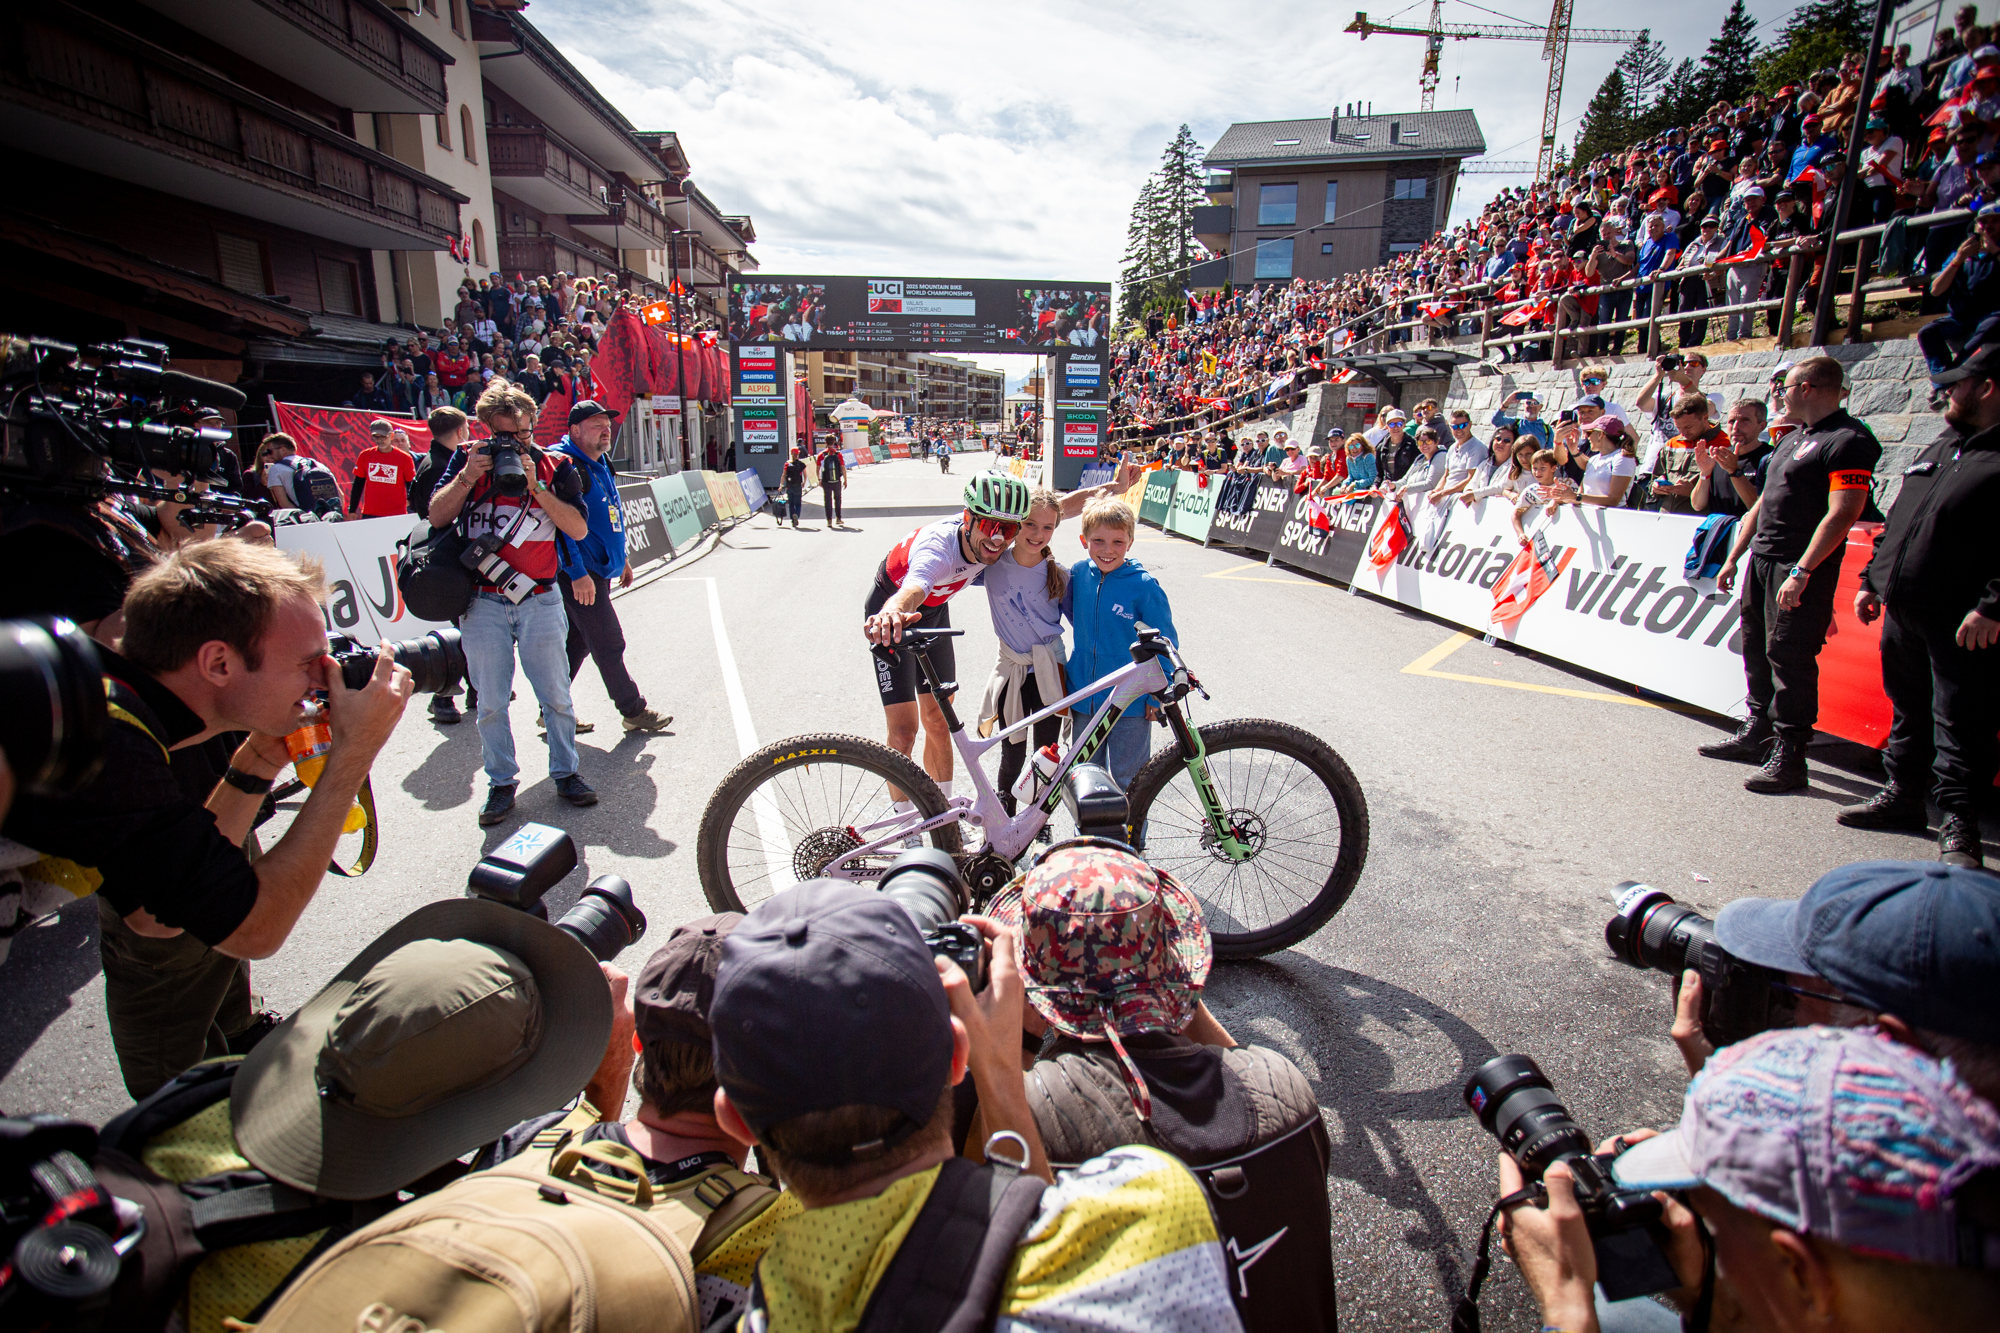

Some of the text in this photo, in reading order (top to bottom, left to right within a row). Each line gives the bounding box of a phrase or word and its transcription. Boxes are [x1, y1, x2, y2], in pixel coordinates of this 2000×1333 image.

[874, 284, 900, 294] UCI
[622, 497, 658, 526] CHSNER
[1252, 486, 1289, 513] SNER
[471, 512, 541, 531] PHO
[624, 524, 651, 554] PORT
[1566, 555, 1742, 656] vittori
[877, 658, 893, 692] DEN
[774, 749, 838, 765] MAXXIS
[1048, 710, 1111, 806] SOTT
[1019, 768, 1034, 791] SPONSE
[920, 818, 944, 830] SRAM
[683, 1156, 701, 1168] UCI
